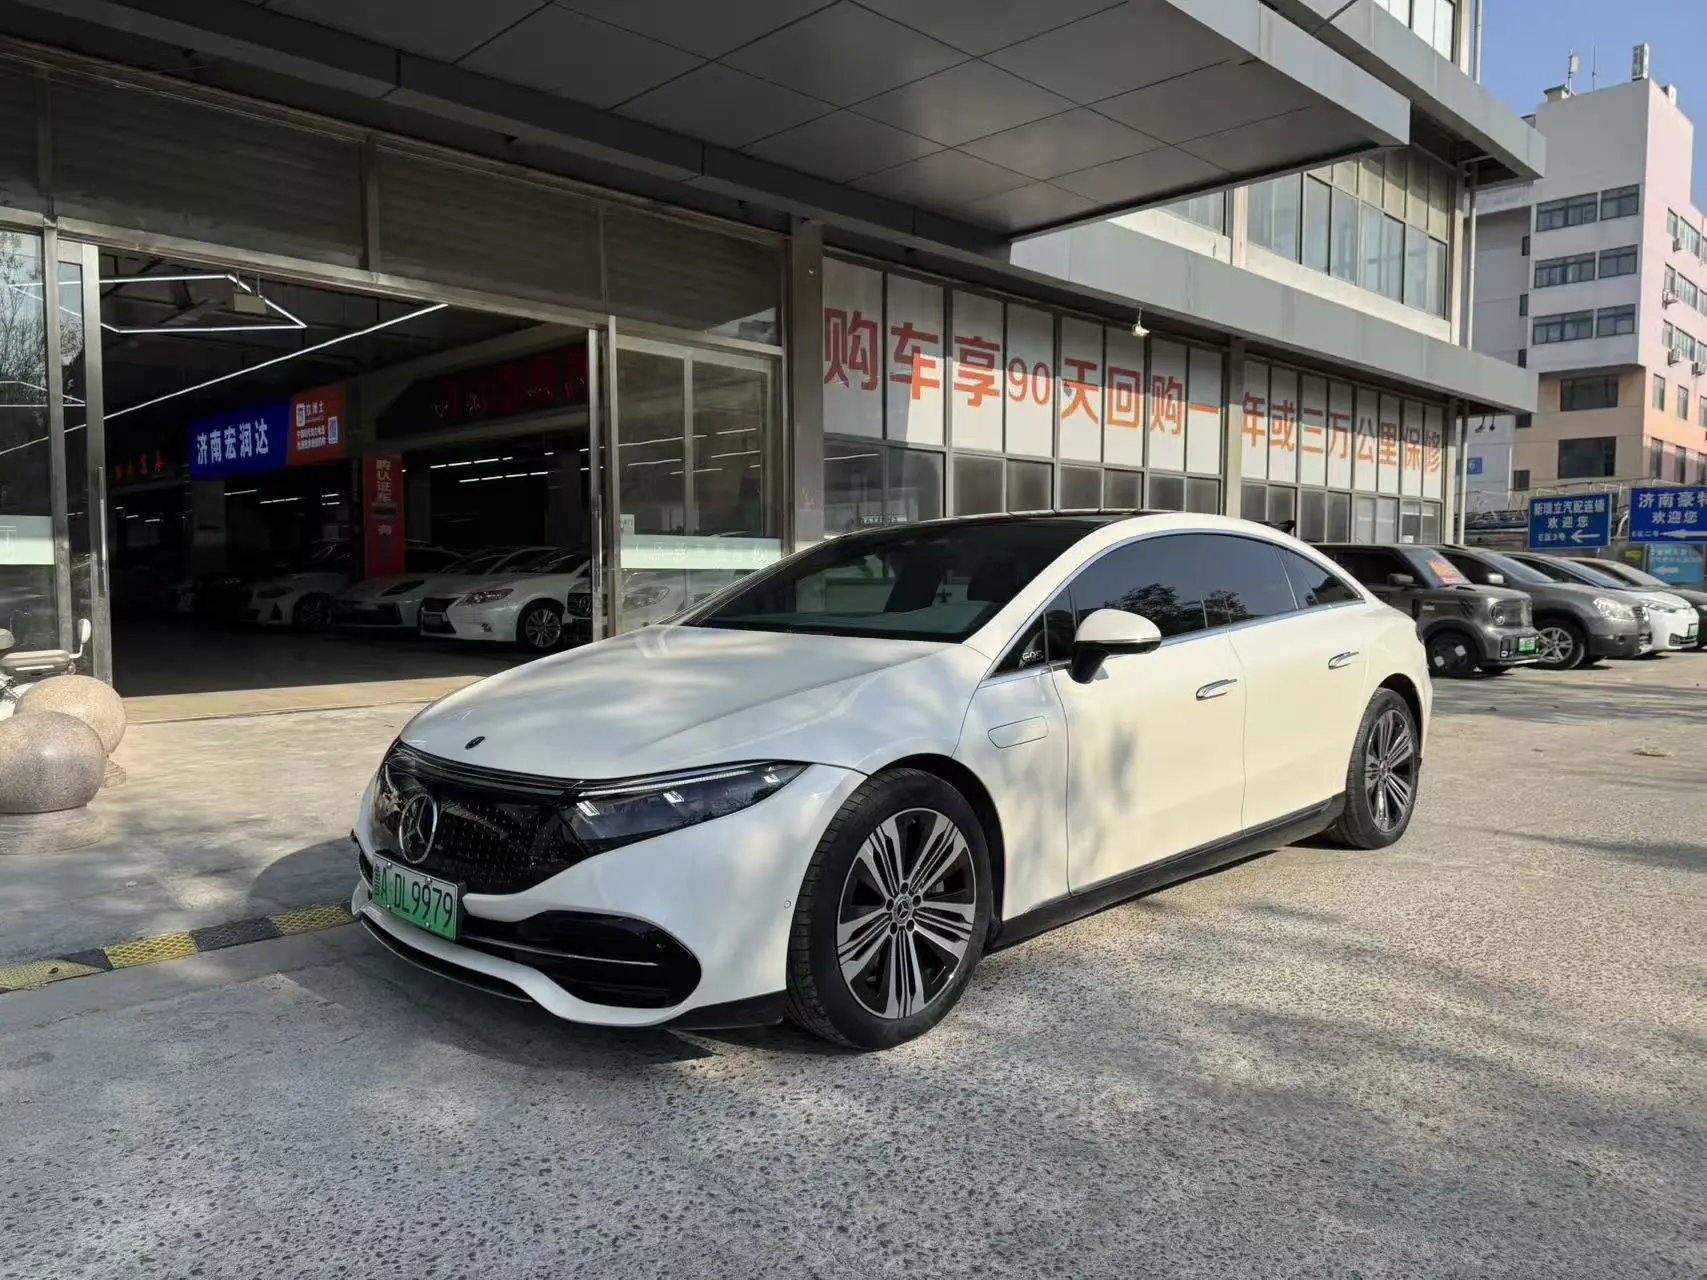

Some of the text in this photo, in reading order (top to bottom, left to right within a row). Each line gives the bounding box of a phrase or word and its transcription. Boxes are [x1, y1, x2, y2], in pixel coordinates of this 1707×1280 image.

[197, 417, 269, 465] 济南宏润达
[1547, 515, 1589, 529] 欢迎您
[1652, 511, 1698, 525] 欢迎您
